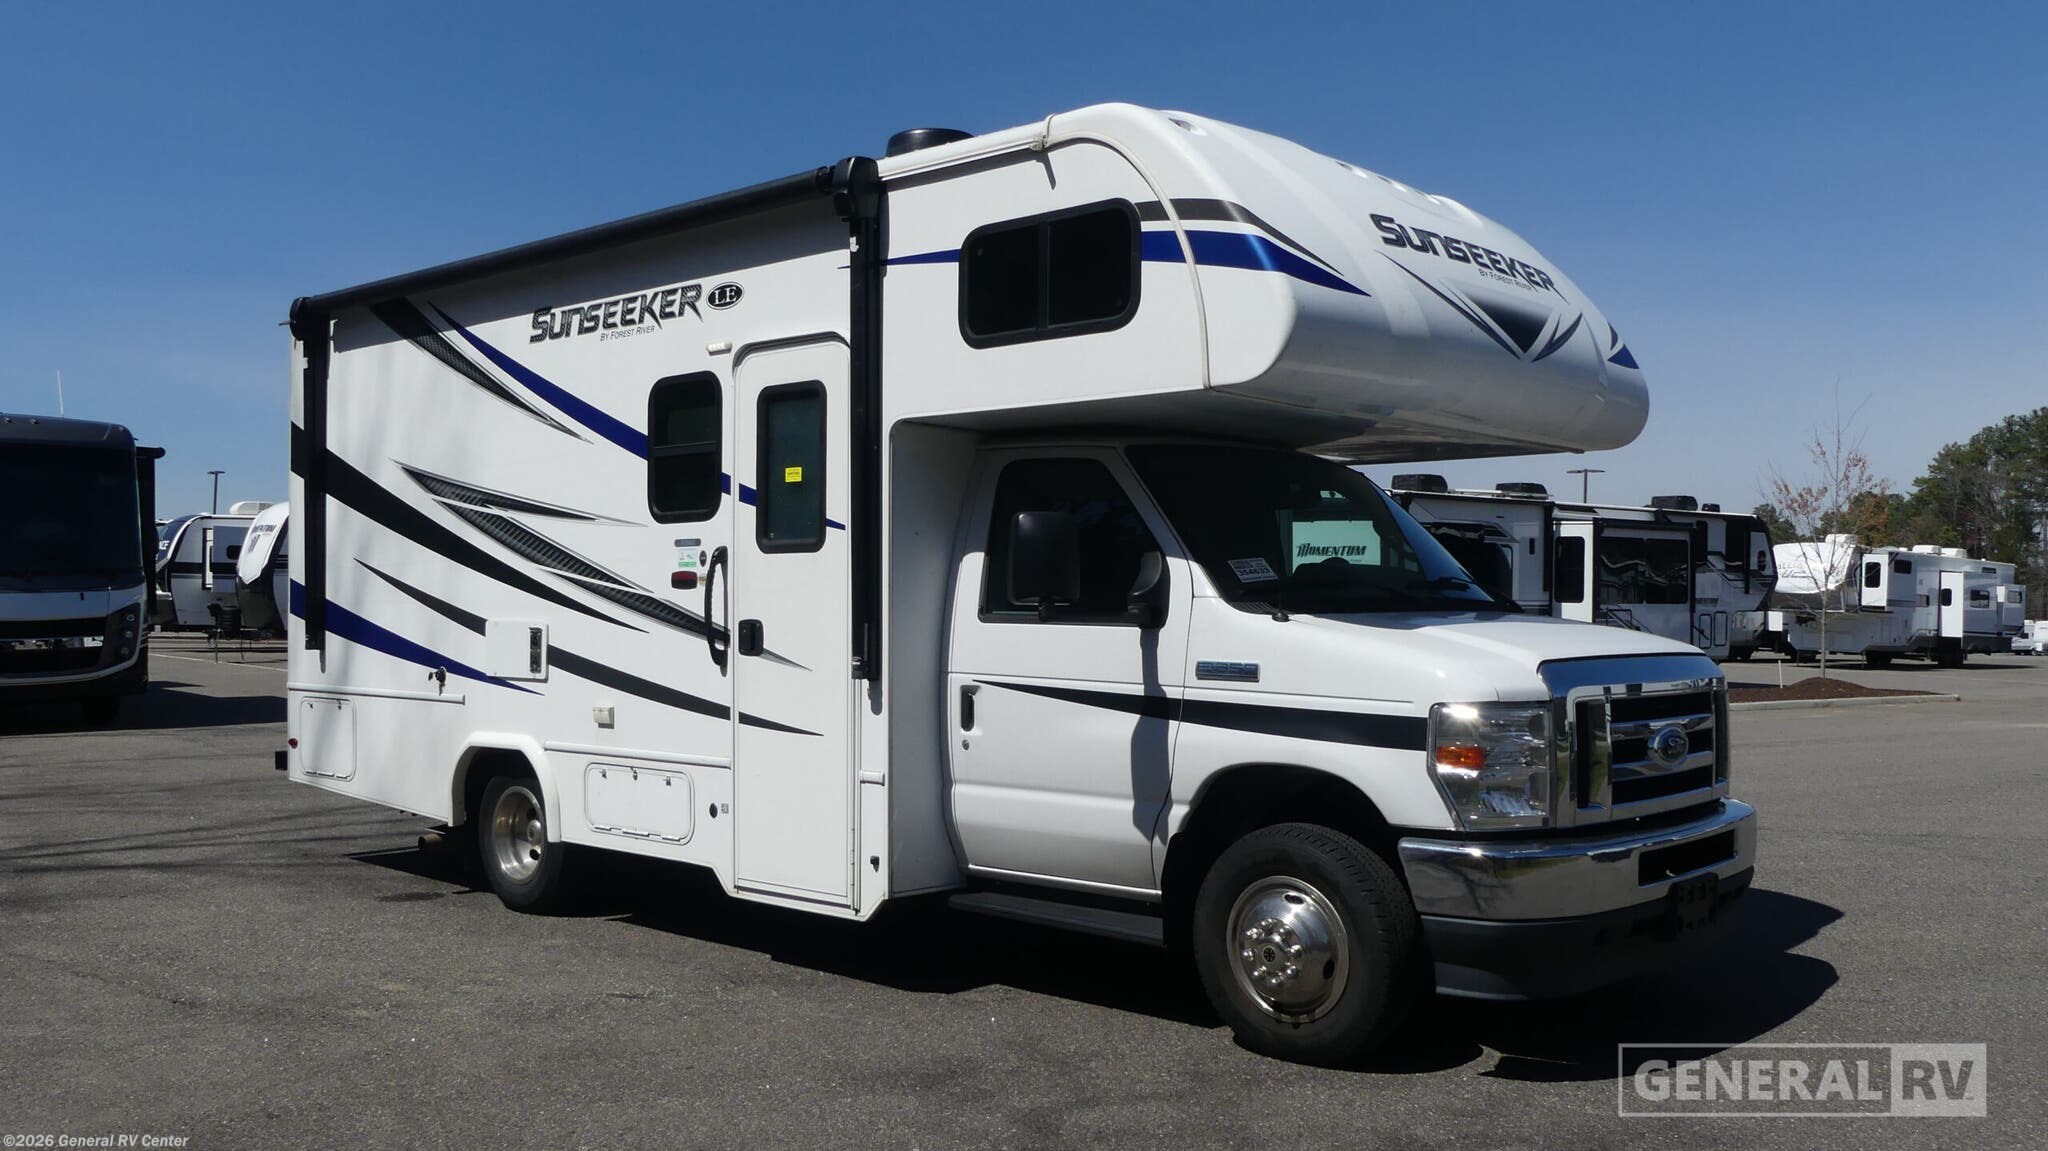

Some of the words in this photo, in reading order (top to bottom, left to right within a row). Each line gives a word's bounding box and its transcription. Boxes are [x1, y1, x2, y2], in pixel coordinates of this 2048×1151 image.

[1370, 213, 1570, 305] SUNSEEKER
[529, 284, 704, 344] SUNSEEKER
[714, 286, 737, 305] LE
[600, 332, 609, 341] BY
[610, 328, 635, 340] FOREST
[636, 325, 655, 335] RIVER
[1296, 543, 1367, 557] MOMENTUM
